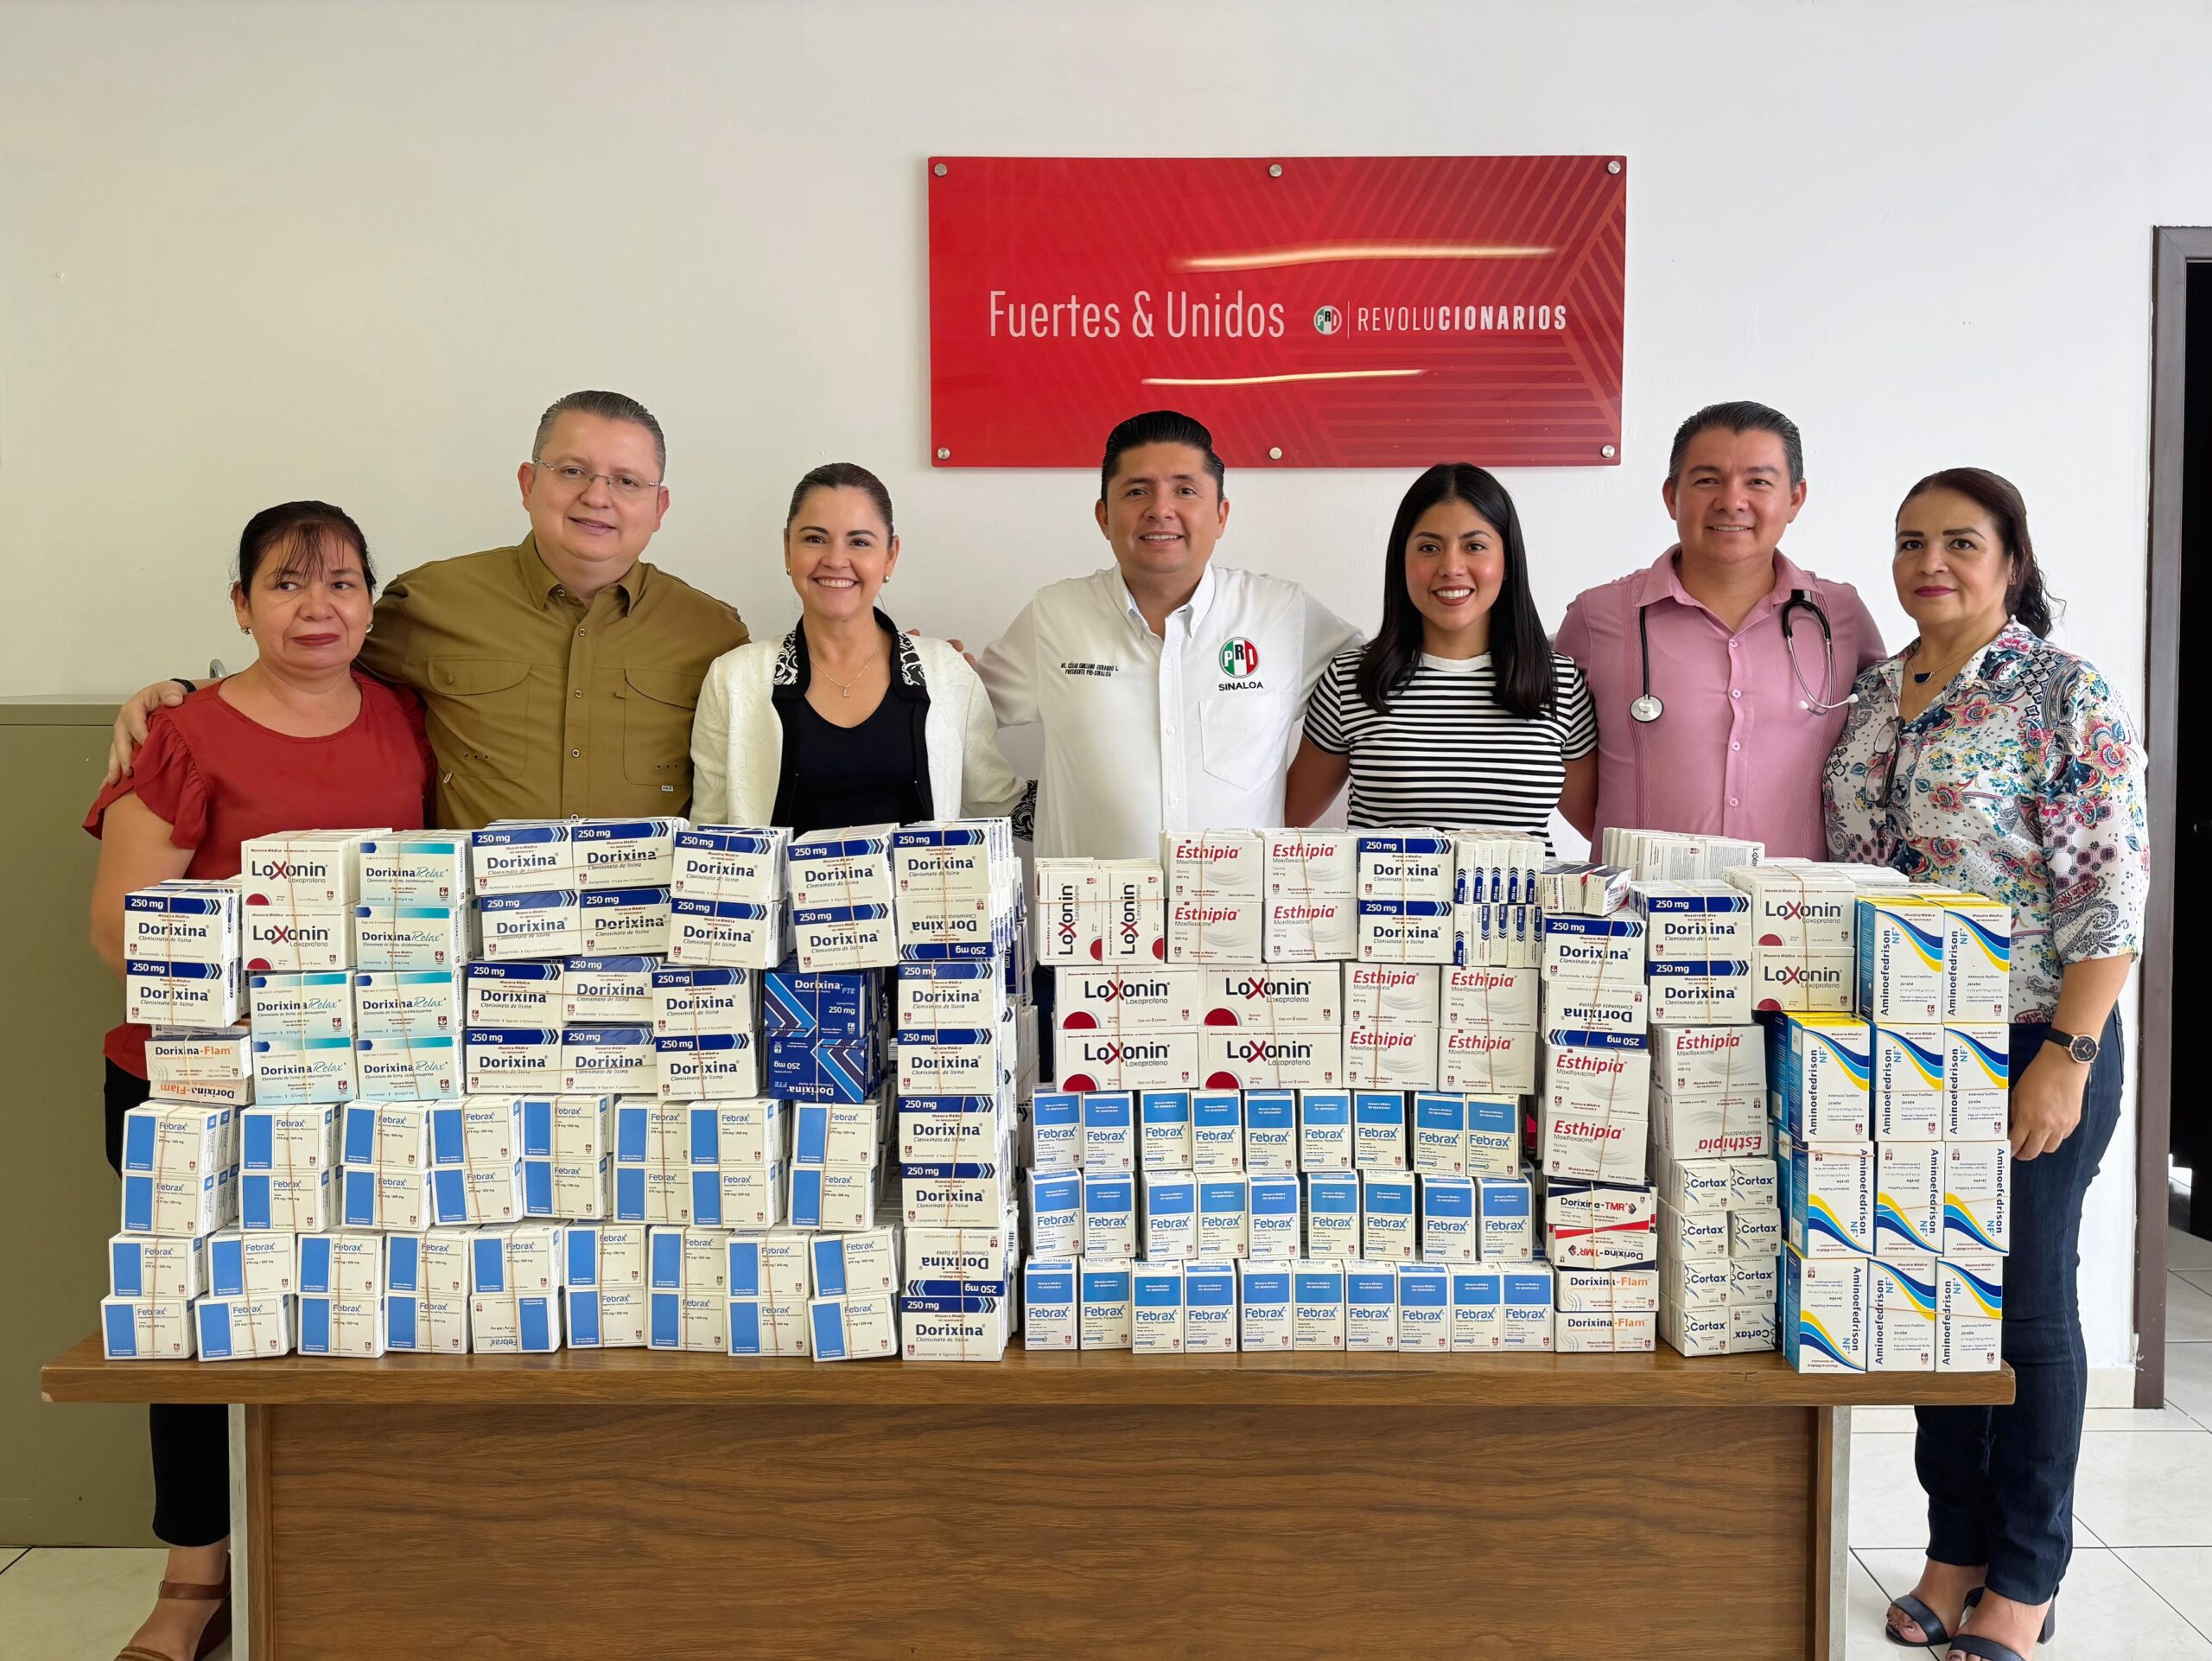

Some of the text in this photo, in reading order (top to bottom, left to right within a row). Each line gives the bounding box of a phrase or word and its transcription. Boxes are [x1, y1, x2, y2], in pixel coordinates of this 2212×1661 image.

[990, 290, 1285, 339] Fuertes & Unidos
[1357, 304, 1567, 333] REVOLUCIONARIOS
[1316, 309, 1339, 334] PRI
[1224, 645, 1255, 667] PRI
[1218, 681, 1263, 691] SINALOA
[916, 837, 930, 846] mg
[588, 850, 657, 863] Dorixina
[1176, 844, 1239, 860] Esthipia
[1273, 843, 1334, 858] Esthipia
[487, 856, 556, 869] Dorixina
[366, 867, 444, 879] Dorixina Relax
[149, 901, 163, 909] mg
[1675, 901, 1688, 910] mg
[1175, 907, 1237, 923] Esthipia
[1274, 905, 1335, 920] Esthipia
[497, 920, 565, 933] Dorixina
[595, 916, 664, 929] Dorixina
[139, 923, 207, 937] Dorixina
[362, 931, 440, 942] Dorixina Relax
[1353, 971, 1416, 986] Esthipia
[1881, 930, 1899, 1015] Aminoefedrison NF
[1948, 931, 1967, 1015] Aminoefedrison NF
[1452, 972, 1515, 988] Esthipia
[141, 987, 208, 1001] Dorixina
[576, 983, 645, 997] Dorixina
[308, 998, 337, 1010] Relax
[414, 997, 443, 1009] Relax
[922, 1034, 935, 1043] mg
[1351, 1031, 1413, 1047] Esthipia
[1448, 1035, 1511, 1051] Esthipia
[1676, 1035, 1740, 1051] Esthipia
[156, 1046, 231, 1056] Dorixina-Flam
[313, 1061, 342, 1073] Relax
[415, 1062, 444, 1072] Relax
[480, 1055, 545, 1068] Dorixina
[912, 1055, 978, 1069] Dorixina
[1557, 1055, 1624, 1073] Esthipia
[1808, 1049, 1827, 1135] Aminoefedrison NF
[1883, 1048, 1901, 1134] Aminoefedrison NF
[1949, 1048, 1967, 1134] Aminoefedrison NF
[466, 1112, 494, 1121] Febrax
[1038, 1126, 1076, 1139] Febrax
[1087, 1130, 1125, 1141] Febrax
[1145, 1125, 1184, 1137] Febrax
[1196, 1130, 1234, 1140] Febrax
[1305, 1128, 1344, 1139] Febrax
[1358, 1127, 1397, 1138] Febrax
[1554, 1120, 1621, 1140] Esthipia
[1249, 1131, 1288, 1142] Febrax
[1419, 1133, 1458, 1144] Febrax
[1470, 1135, 1510, 1147] Febrax
[1554, 1134, 1593, 1143] Moxifloxacino
[1699, 1136, 1762, 1149] Esthipia
[1691, 1179, 1726, 1188] Cortax
[1737, 1176, 1773, 1186] Cortax
[1987, 1149, 2005, 1234] Aminoefedrison NF
[1038, 1212, 1075, 1225] Febrax
[1088, 1215, 1128, 1226] Febrax
[1202, 1214, 1240, 1226] Febrax
[1313, 1217, 1352, 1227] Febrax
[1485, 1219, 1525, 1231] Febrax
[1688, 1226, 1724, 1235] Cortax
[1741, 1225, 1777, 1234] Cortax
[1850, 1221, 1858, 1234] NF
[1920, 1220, 1927, 1233] NF
[245, 1243, 276, 1251] Febrax
[846, 1240, 874, 1251] Febrax
[1570, 1277, 1648, 1286] Dorixina-Flam
[1691, 1274, 1726, 1283] Cortax
[1737, 1271, 1772, 1280] Cortax
[1885, 1281, 1893, 1293] NF
[1028, 1306, 1068, 1319] Febrax
[1135, 1309, 1176, 1321] Febrax
[1244, 1306, 1285, 1318] Febrax
[1349, 1307, 1389, 1318] Febrax
[1505, 1308, 1546, 1318] Febrax
[1843, 1267, 1861, 1351] Aminoefedrison NF
[1567, 1318, 1645, 1327] Dorixina-Flam
[1690, 1321, 1726, 1331] Cortax
[1942, 1281, 1961, 1365] Aminoefedrison NF
[916, 1324, 983, 1336] Dorixina
[1735, 1329, 1770, 1339] Cortax
